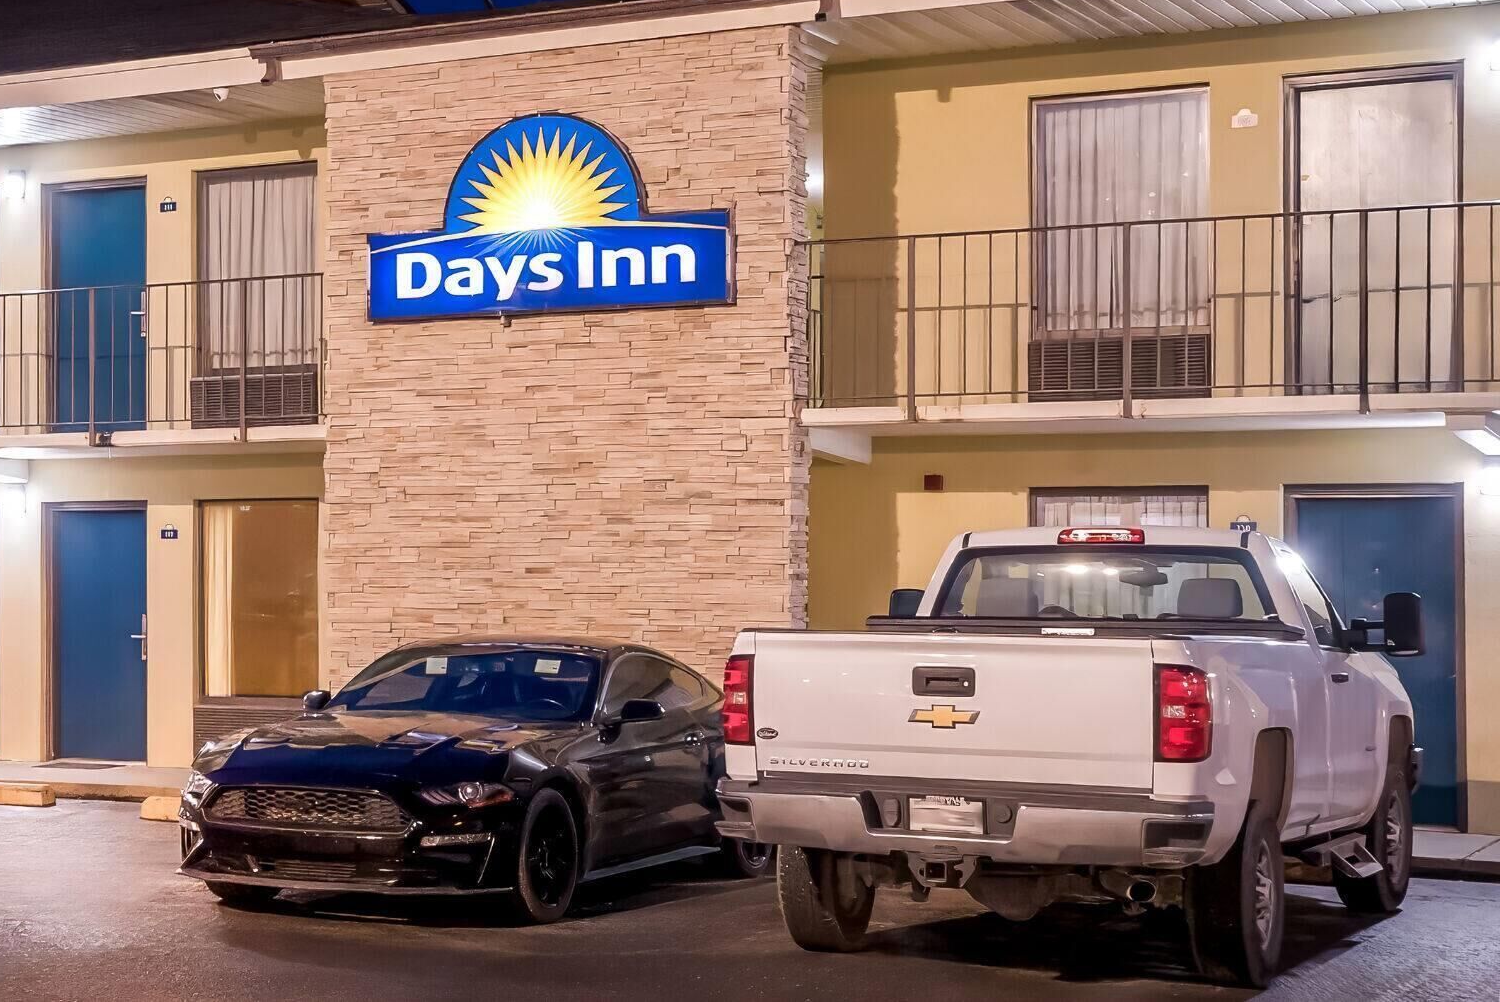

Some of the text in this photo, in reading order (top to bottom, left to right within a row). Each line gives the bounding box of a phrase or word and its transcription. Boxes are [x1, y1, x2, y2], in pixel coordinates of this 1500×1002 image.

[396, 241, 696, 301] Days Inn
[770, 756, 869, 769] SILVERADO
